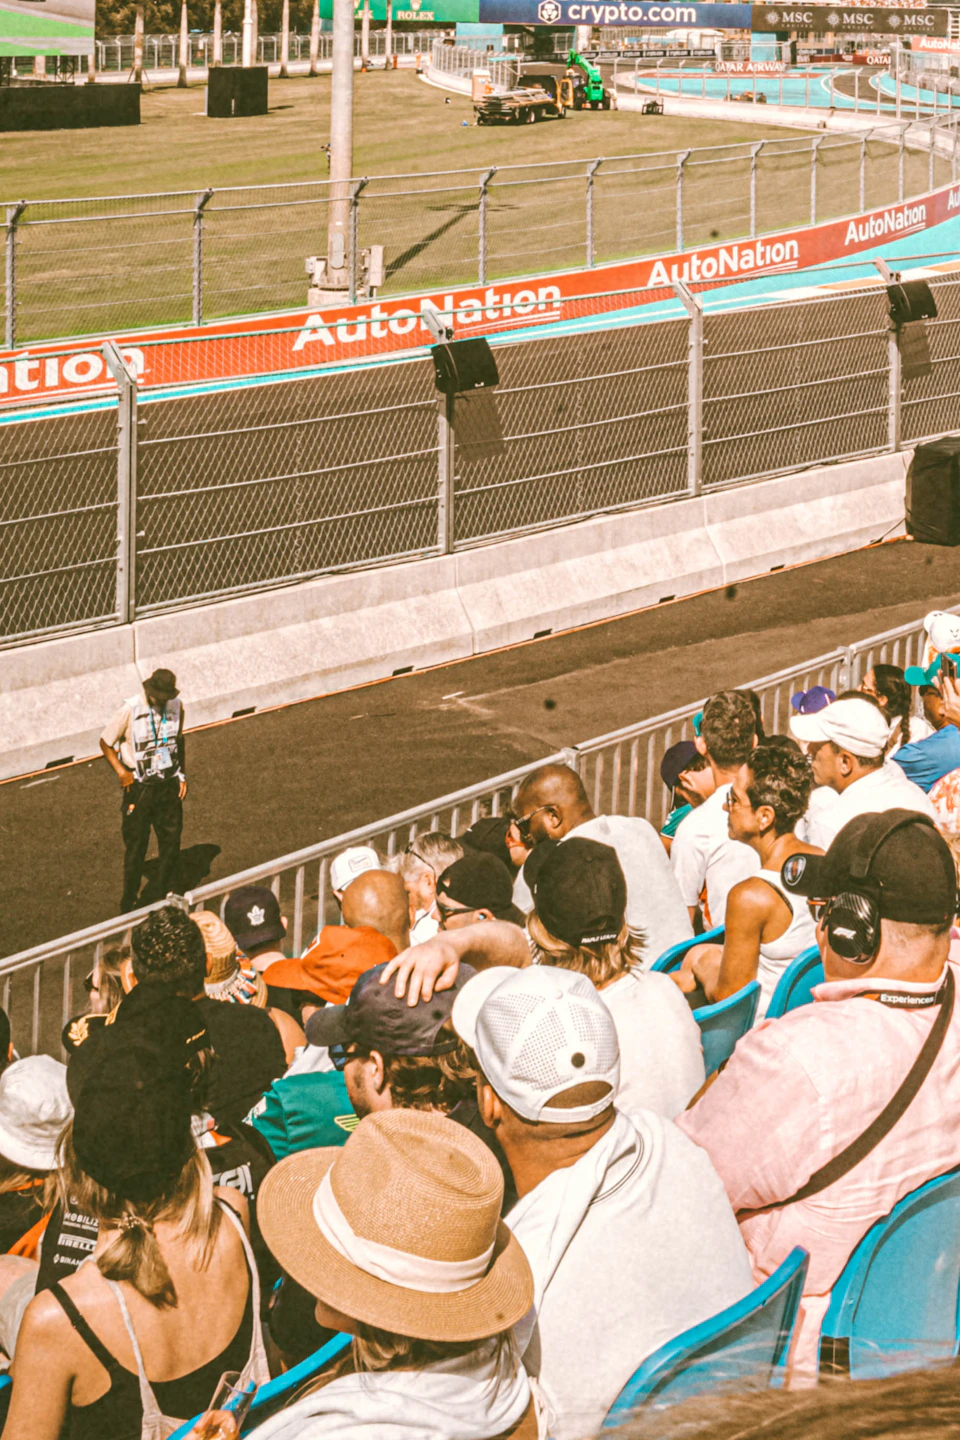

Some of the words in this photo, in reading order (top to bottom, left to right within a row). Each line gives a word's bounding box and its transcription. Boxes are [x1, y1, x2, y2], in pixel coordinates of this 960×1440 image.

[397, 11, 434, 20] ROLEX
[568, 2, 697, 24] crypto.com
[782, 11, 813, 24] MSC
[842, 12, 874, 25] MSC
[903, 14, 935, 26] MSC
[715, 62, 744, 72] QATAR
[844, 203, 927, 246] AutoNation
[646, 238, 799, 287] AutoNation
[291, 284, 562, 352] AutoNation
[0, 351, 145, 393] tion
[880, 993, 935, 1006] Experiences
